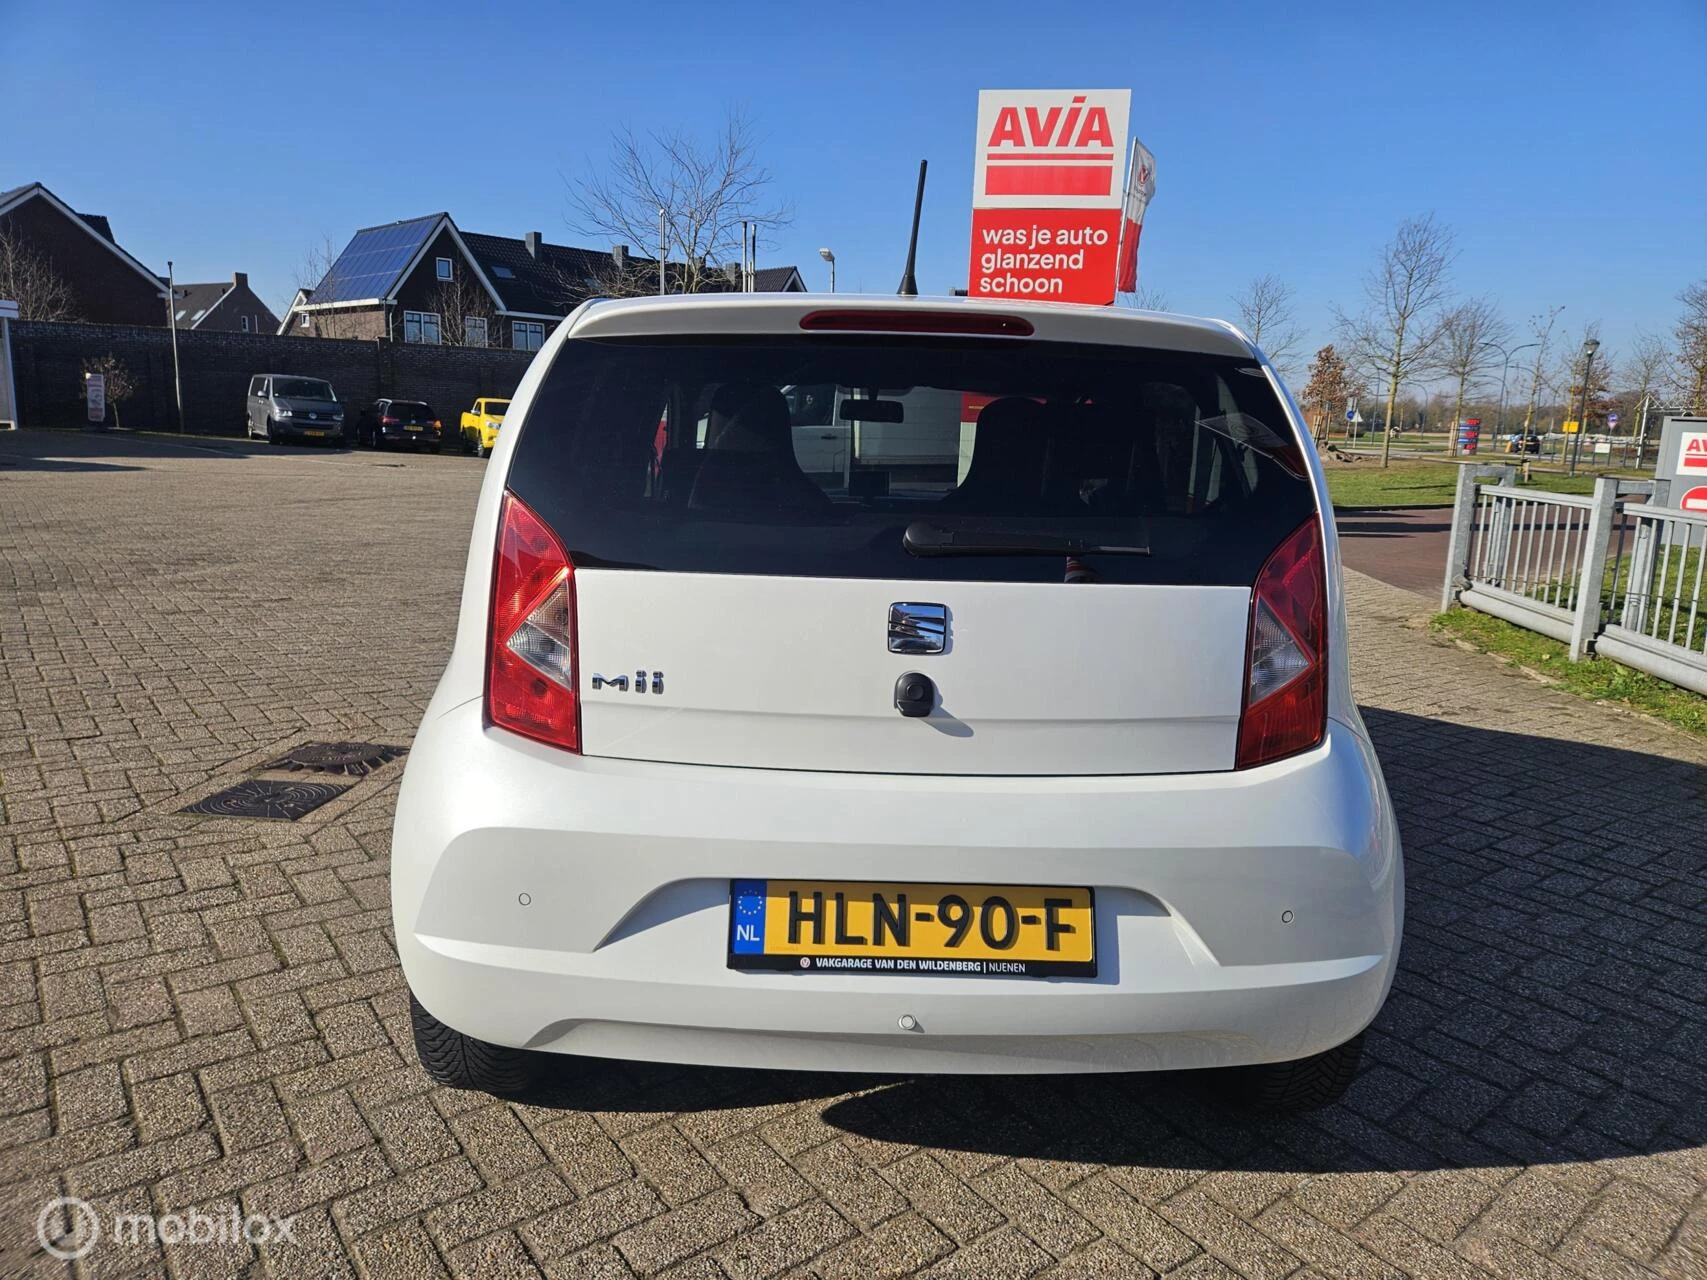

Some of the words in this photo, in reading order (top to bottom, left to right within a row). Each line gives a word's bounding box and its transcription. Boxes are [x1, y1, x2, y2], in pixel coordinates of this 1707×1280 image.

[982, 227, 1027, 245] was
[1028, 224, 1052, 249] je
[1055, 226, 1109, 245] auto
[980, 248, 1085, 274] glanzend
[979, 273, 1064, 294] schoon
[591, 669, 666, 695] Mii
[736, 924, 761, 942] NL
[787, 890, 1076, 952] HLN-90-F
[815, 957, 873, 969] VAKGARAGE
[874, 958, 895, 969] VAN
[896, 959, 917, 970] DEN
[918, 960, 981, 972] WILDENBERG
[988, 962, 1026, 973] NUENEN
